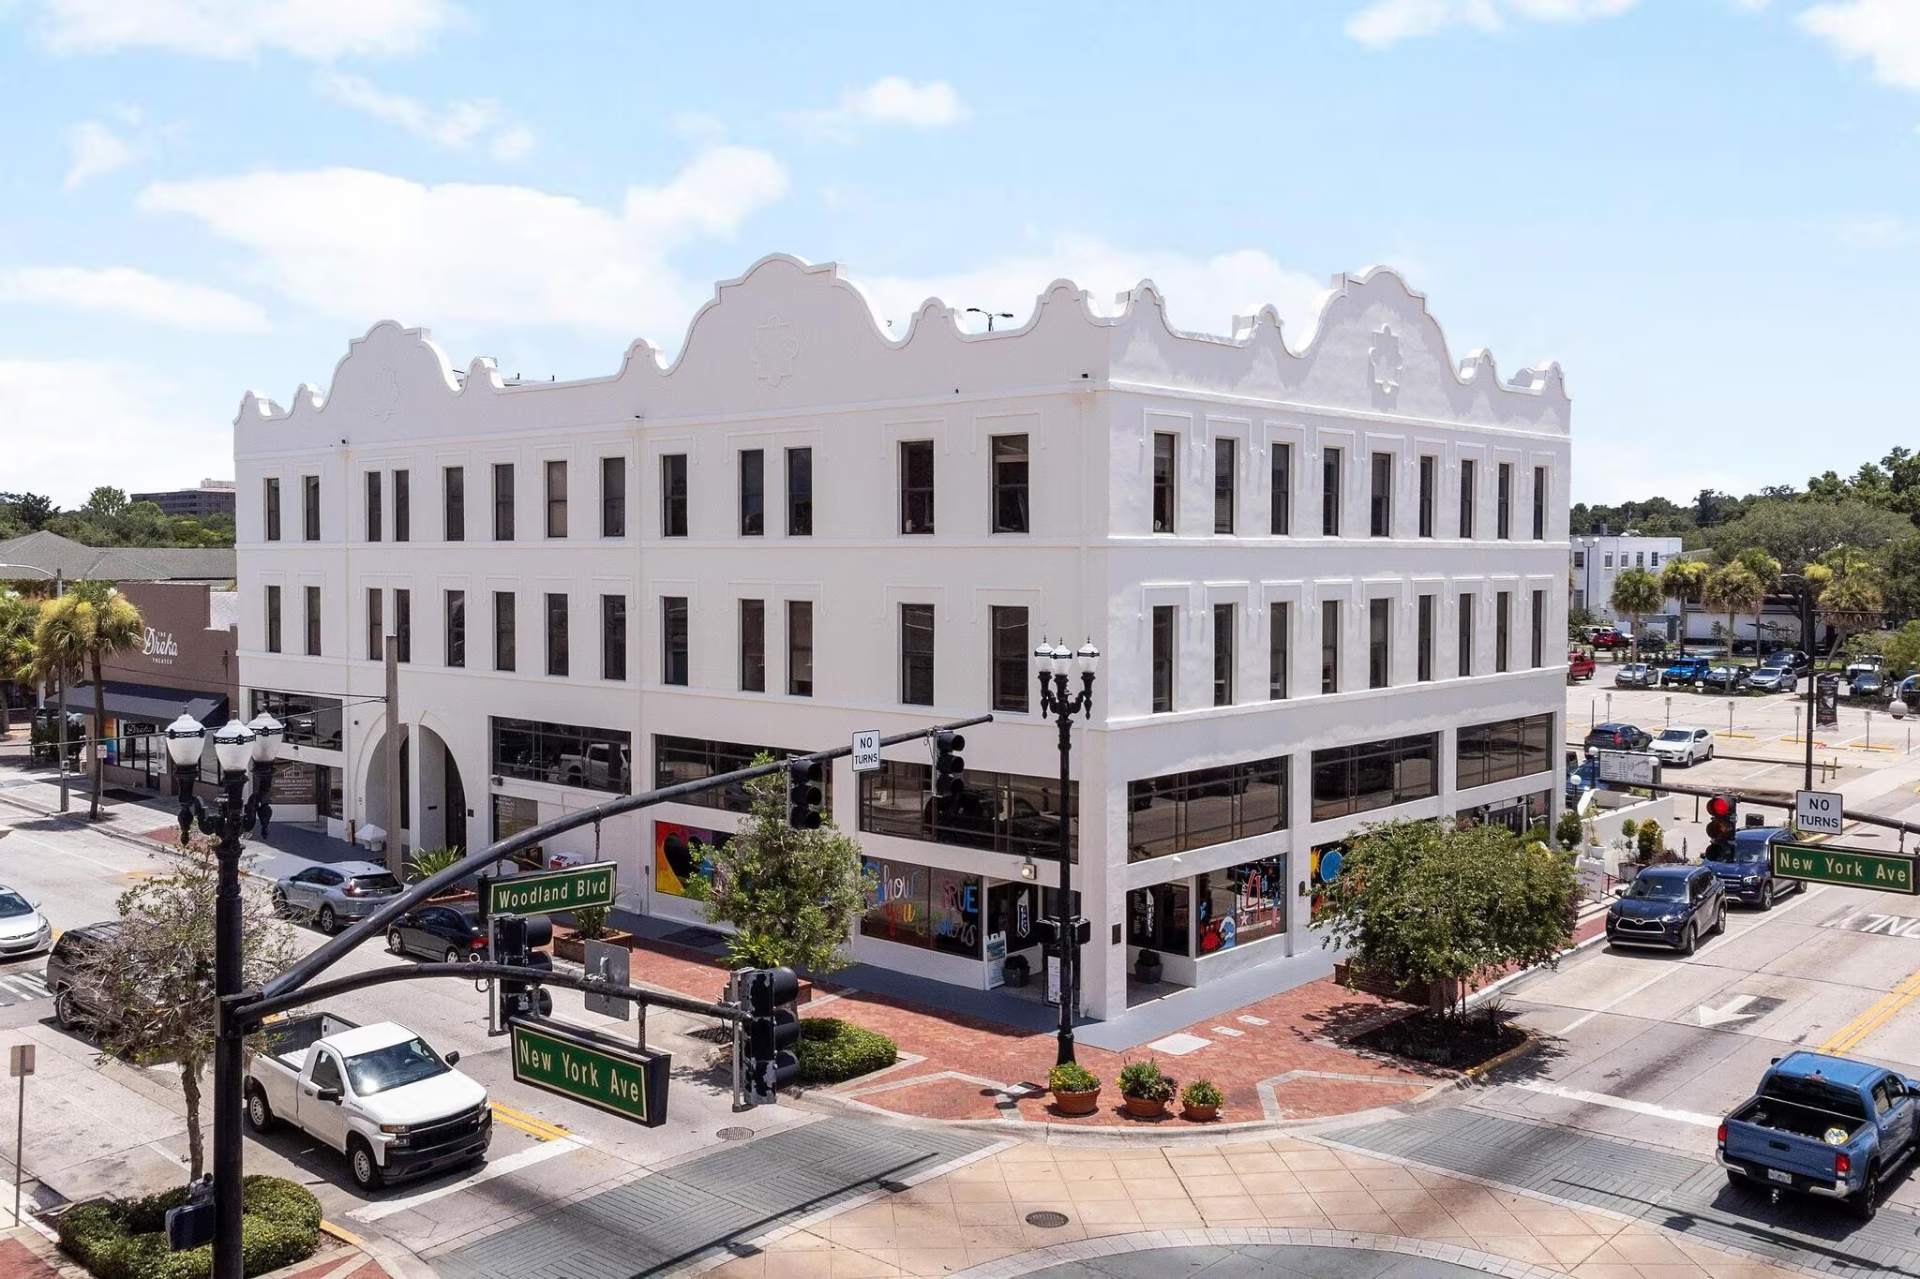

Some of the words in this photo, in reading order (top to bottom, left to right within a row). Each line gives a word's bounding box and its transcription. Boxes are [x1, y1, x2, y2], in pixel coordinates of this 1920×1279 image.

[142, 626, 178, 656] Dreka
[860, 736, 873, 748] NO
[854, 753, 878, 764] TURNS
[1809, 798, 1830, 811] NO
[1800, 815, 1839, 828] TURNS
[1780, 853, 1813, 871] New
[1825, 858, 1863, 877] York
[1876, 863, 1906, 882] Ave
[499, 882, 568, 909] Woodland
[577, 877, 606, 897] Blvd
[520, 1039, 551, 1071] New
[562, 1052, 599, 1087] York
[610, 1069, 639, 1102] Ave
